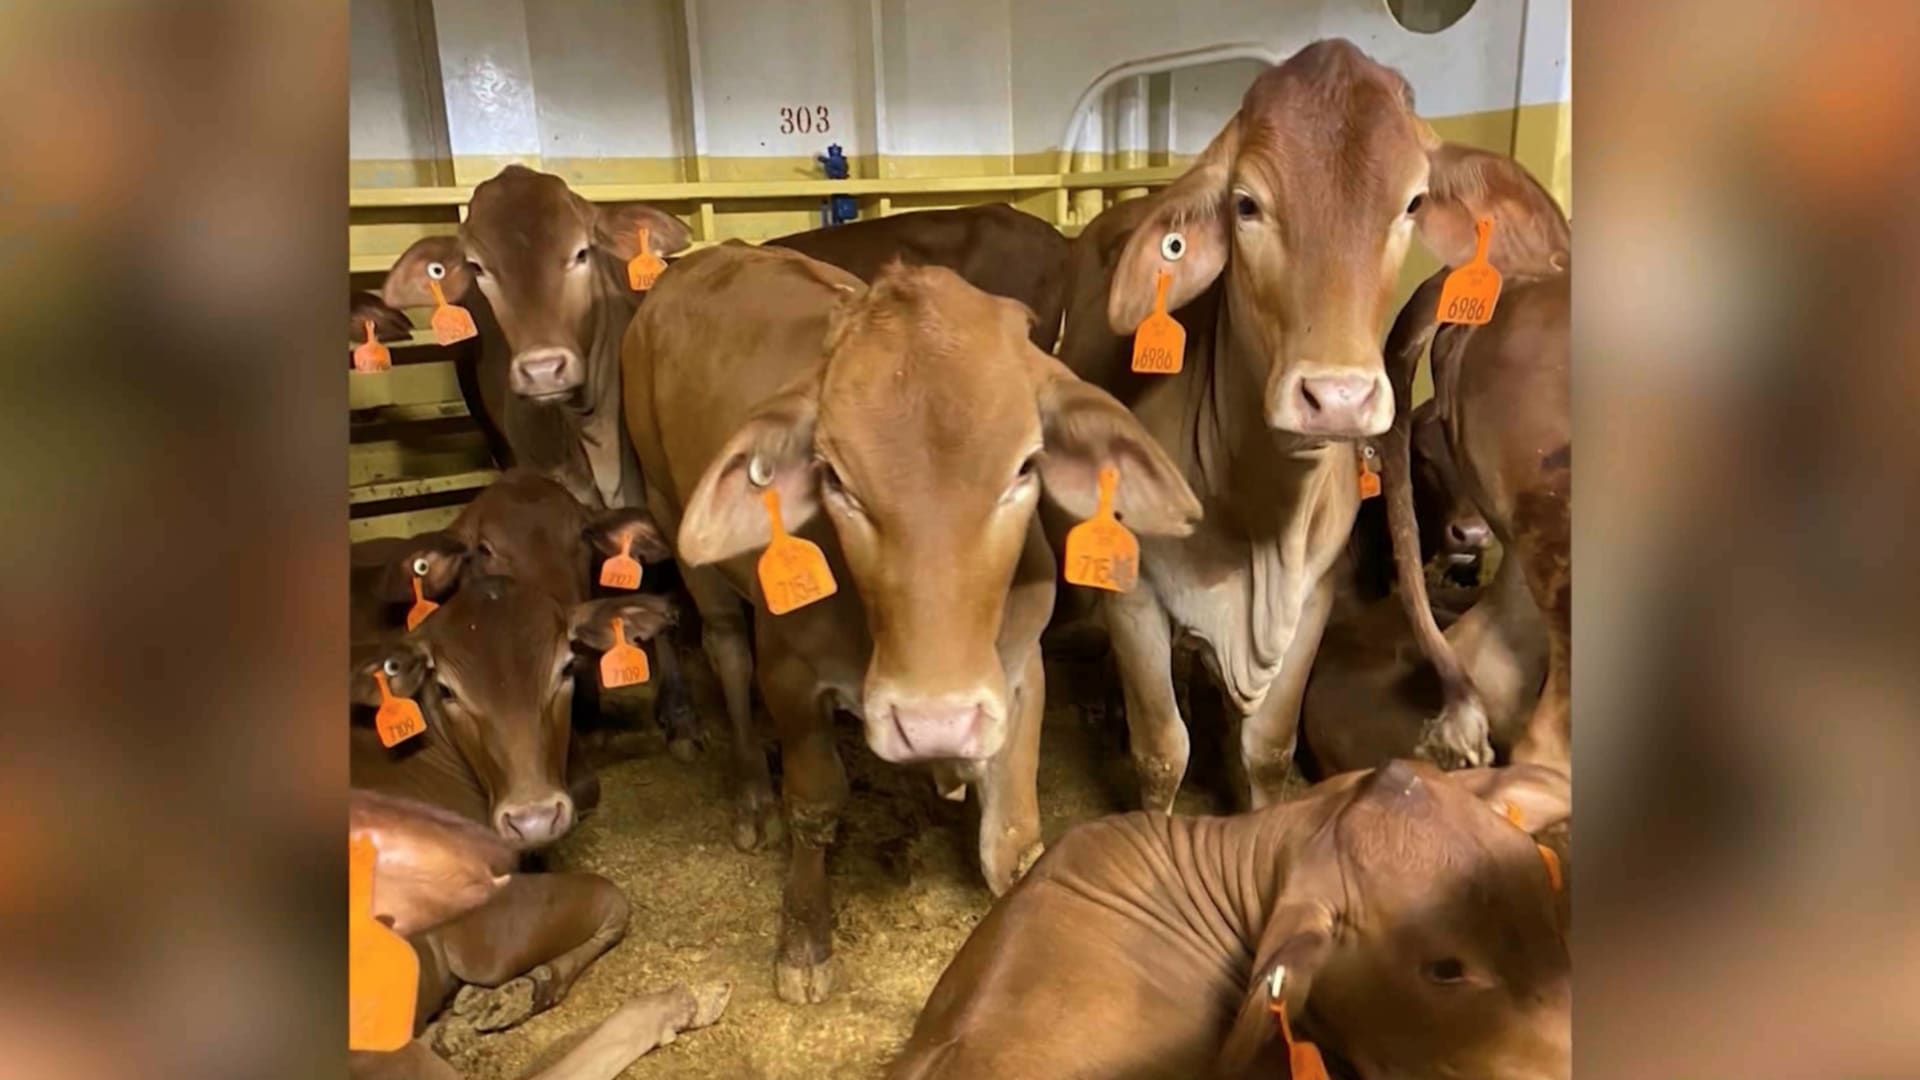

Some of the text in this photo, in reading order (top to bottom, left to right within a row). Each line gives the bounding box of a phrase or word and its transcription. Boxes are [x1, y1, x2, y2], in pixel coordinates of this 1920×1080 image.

[780, 105, 830, 134] 303
[1447, 295, 1488, 321] 6986
[1139, 345, 1173, 370] 6986
